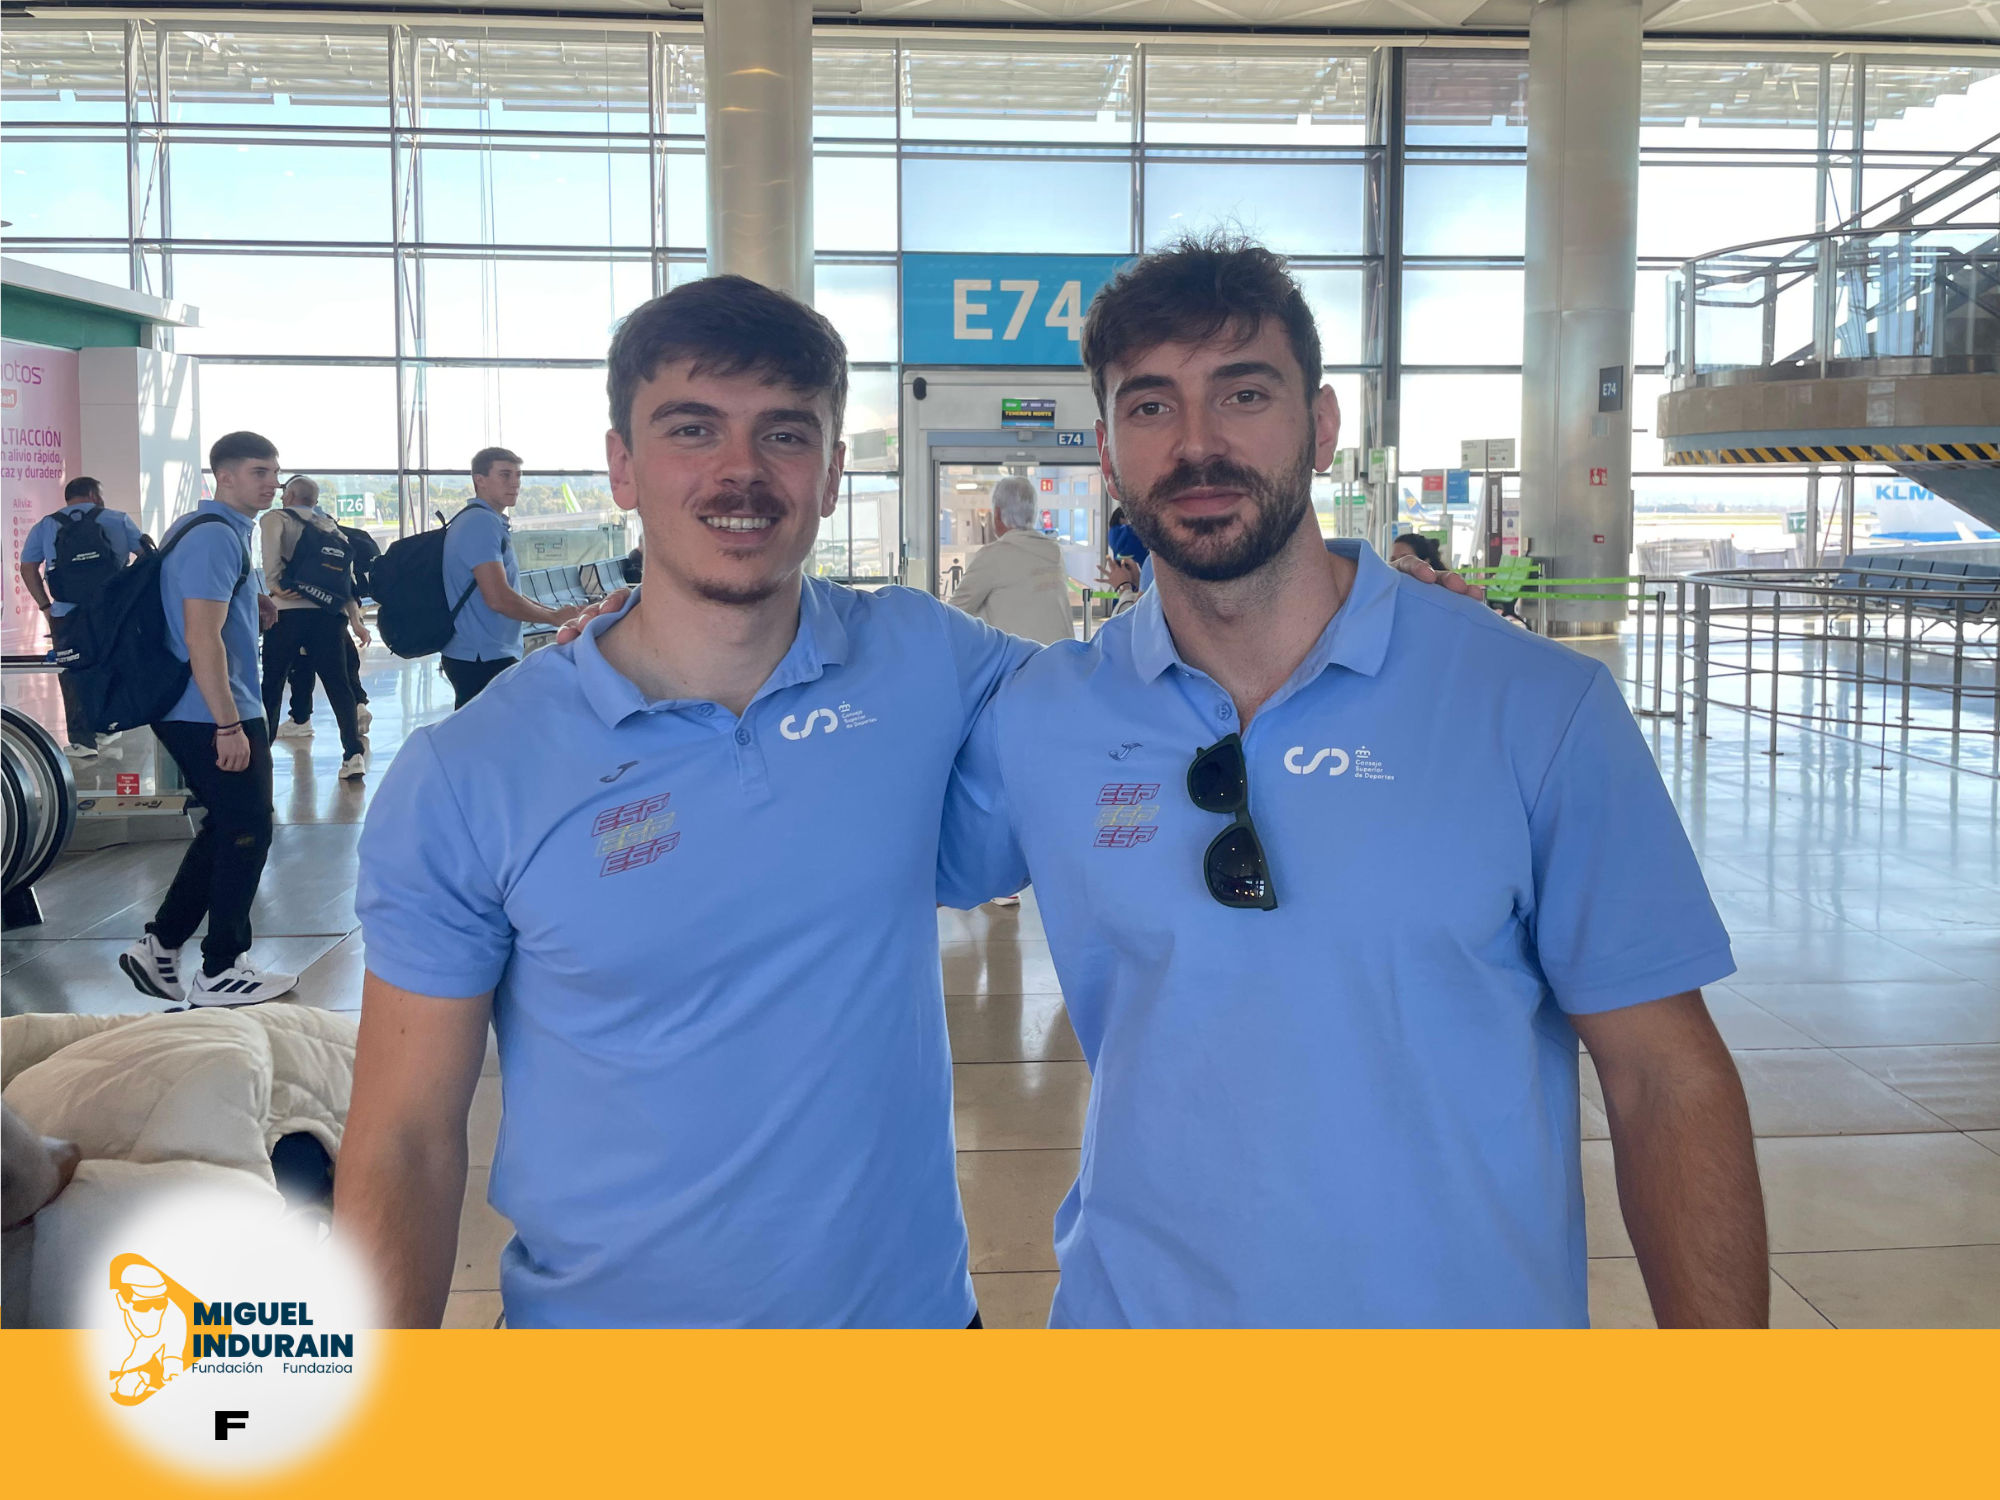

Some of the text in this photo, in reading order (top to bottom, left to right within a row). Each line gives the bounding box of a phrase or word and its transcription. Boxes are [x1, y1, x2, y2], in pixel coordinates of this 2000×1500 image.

[954, 279, 1084, 341] E74
[1602, 382, 1616, 396] E74
[1058, 433, 1082, 445] E74
[8, 449, 31, 462] alivio
[34, 449, 62, 465] rápido,
[18, 468, 22, 481] y
[25, 465, 62, 479] duradero
[1876, 484, 1934, 500] KLM
[337, 497, 364, 512] T26
[1096, 783, 1160, 805] ESP
[591, 792, 671, 837] ESP
[1093, 825, 1158, 848] ESP
[599, 831, 681, 878] ESP
